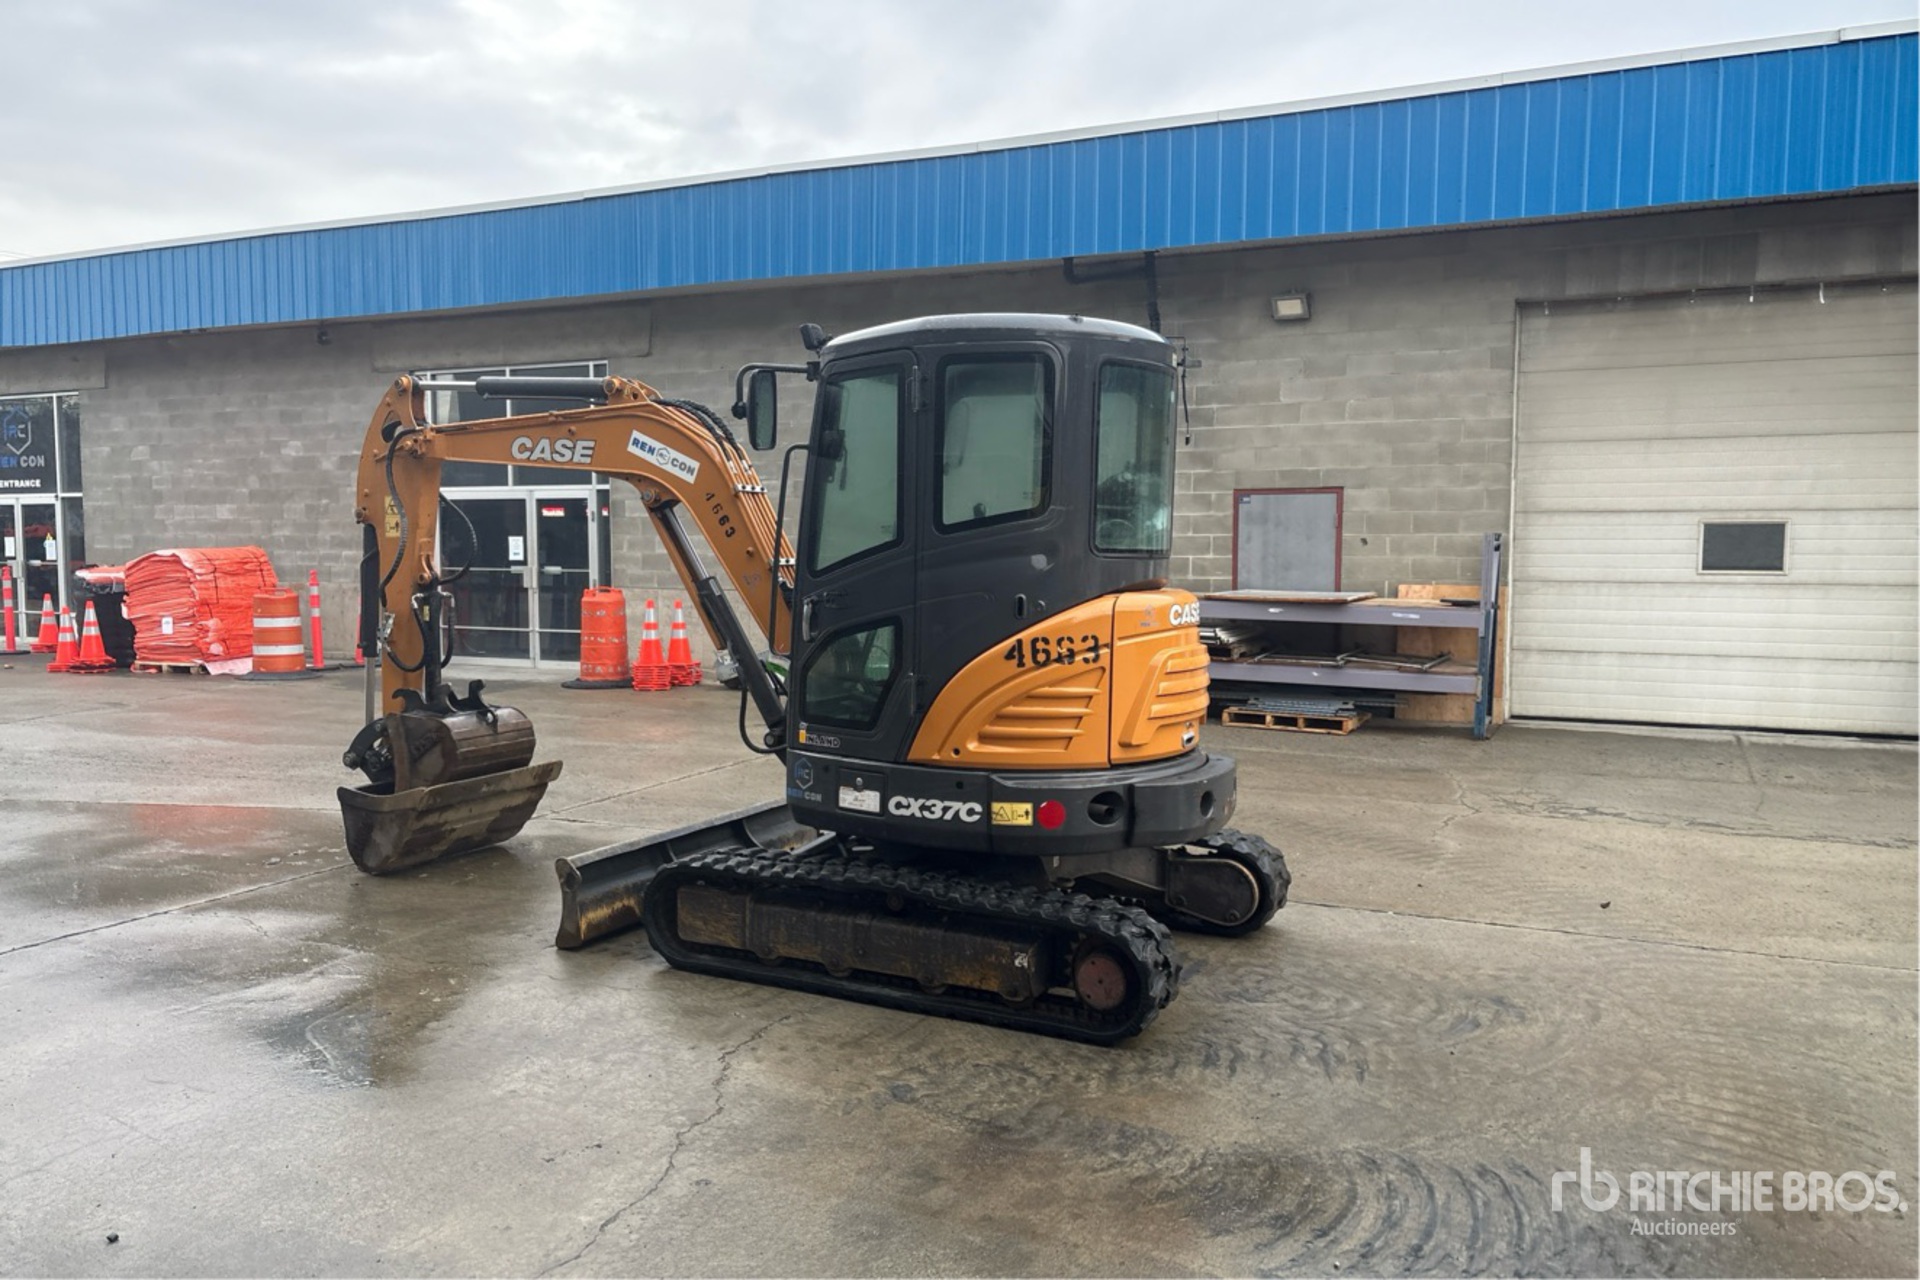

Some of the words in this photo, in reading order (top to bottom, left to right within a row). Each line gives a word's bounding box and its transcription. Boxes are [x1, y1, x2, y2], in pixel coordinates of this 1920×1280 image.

[20, 455, 45, 467] CON
[511, 436, 596, 464] CASE
[632, 437, 656, 456] REN
[671, 457, 696, 476] CON
[0, 479, 41, 488] ENTRANCE
[1004, 634, 1100, 668] 4663
[888, 796, 983, 822] CX37C
